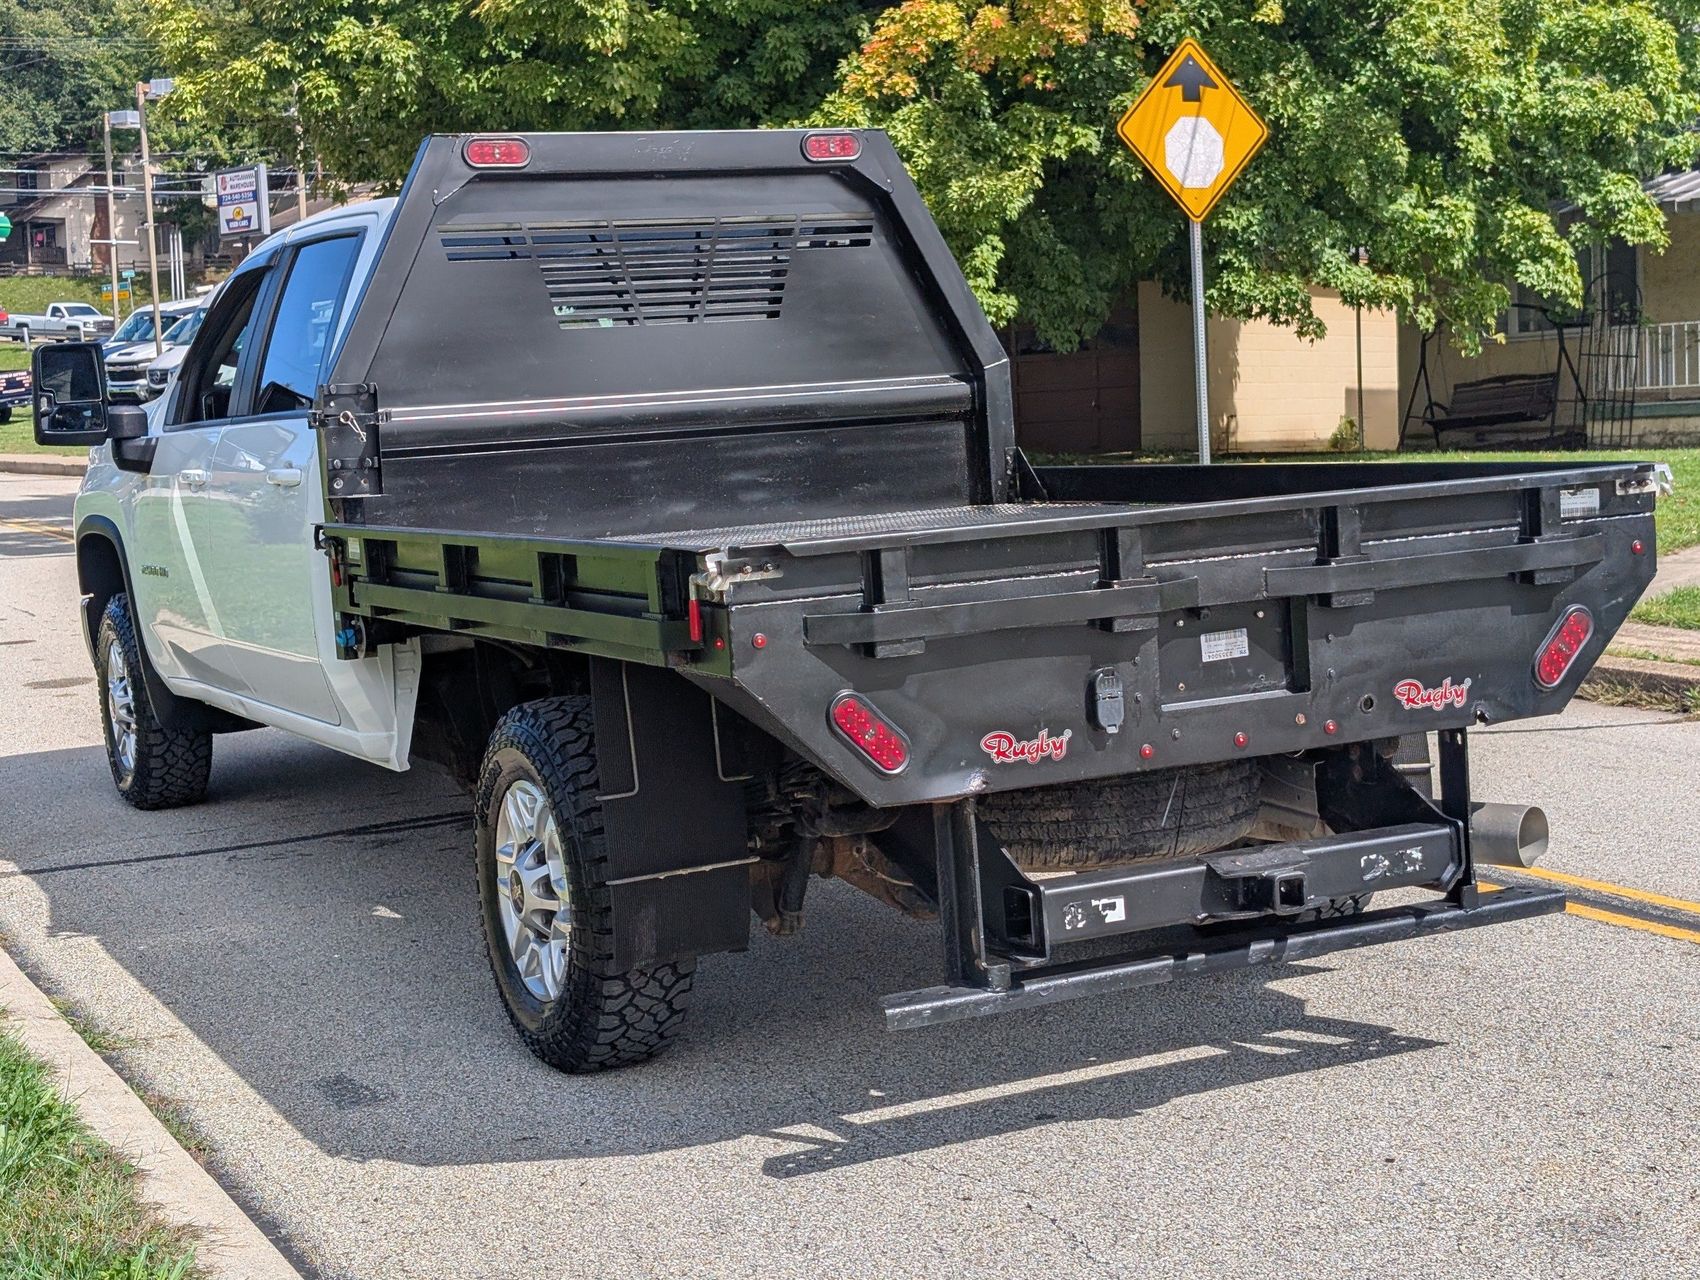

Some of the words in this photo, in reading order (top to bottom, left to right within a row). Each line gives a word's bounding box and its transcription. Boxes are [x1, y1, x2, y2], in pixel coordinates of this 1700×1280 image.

[229, 180, 255, 190] WAREHOUSE
[238, 220, 249, 228] CARS
[1393, 676, 1467, 711] Rugby
[980, 728, 1068, 764] Rugby
